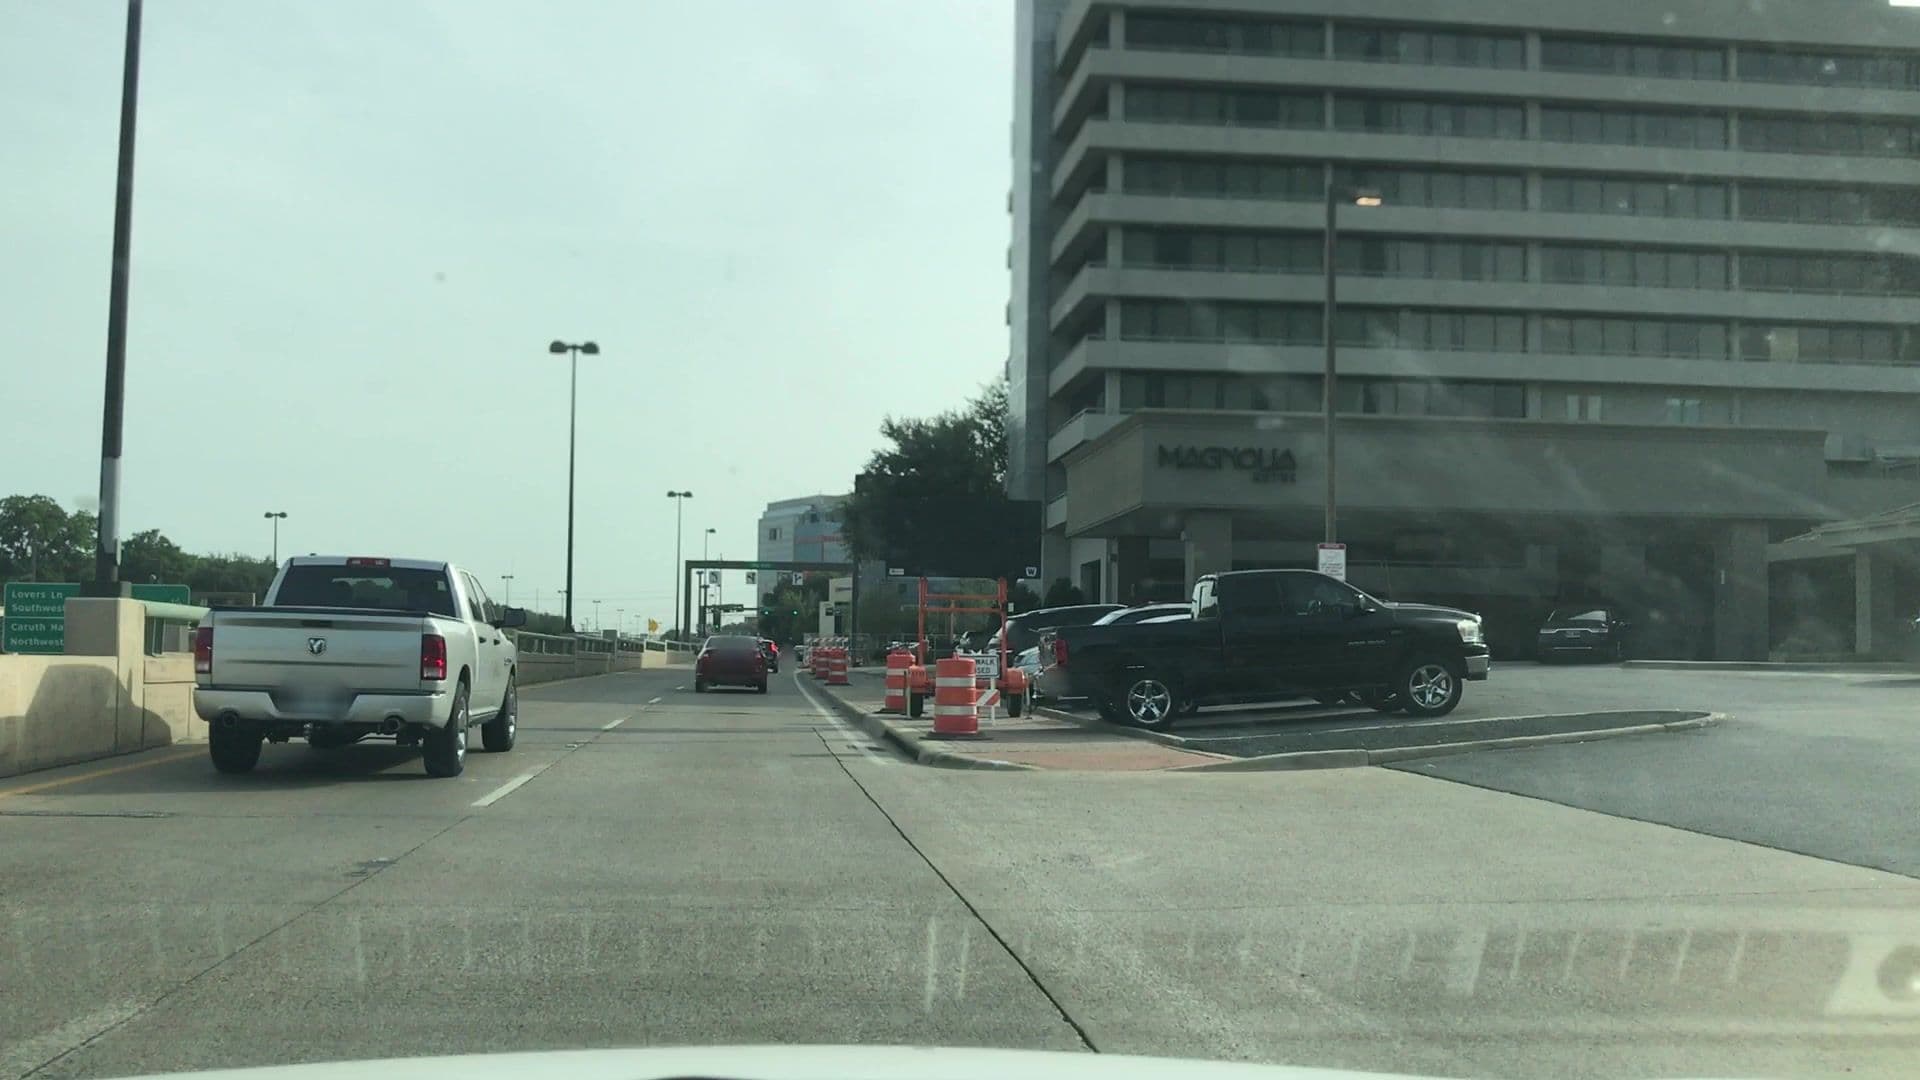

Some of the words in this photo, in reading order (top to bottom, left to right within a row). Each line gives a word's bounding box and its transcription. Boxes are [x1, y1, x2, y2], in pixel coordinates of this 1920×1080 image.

[1157, 444, 1297, 472] MAGNOLIA
[11, 589, 46, 599] Lovers
[51, 591, 63, 599] Ln
[11, 623, 46, 632] Caruth
